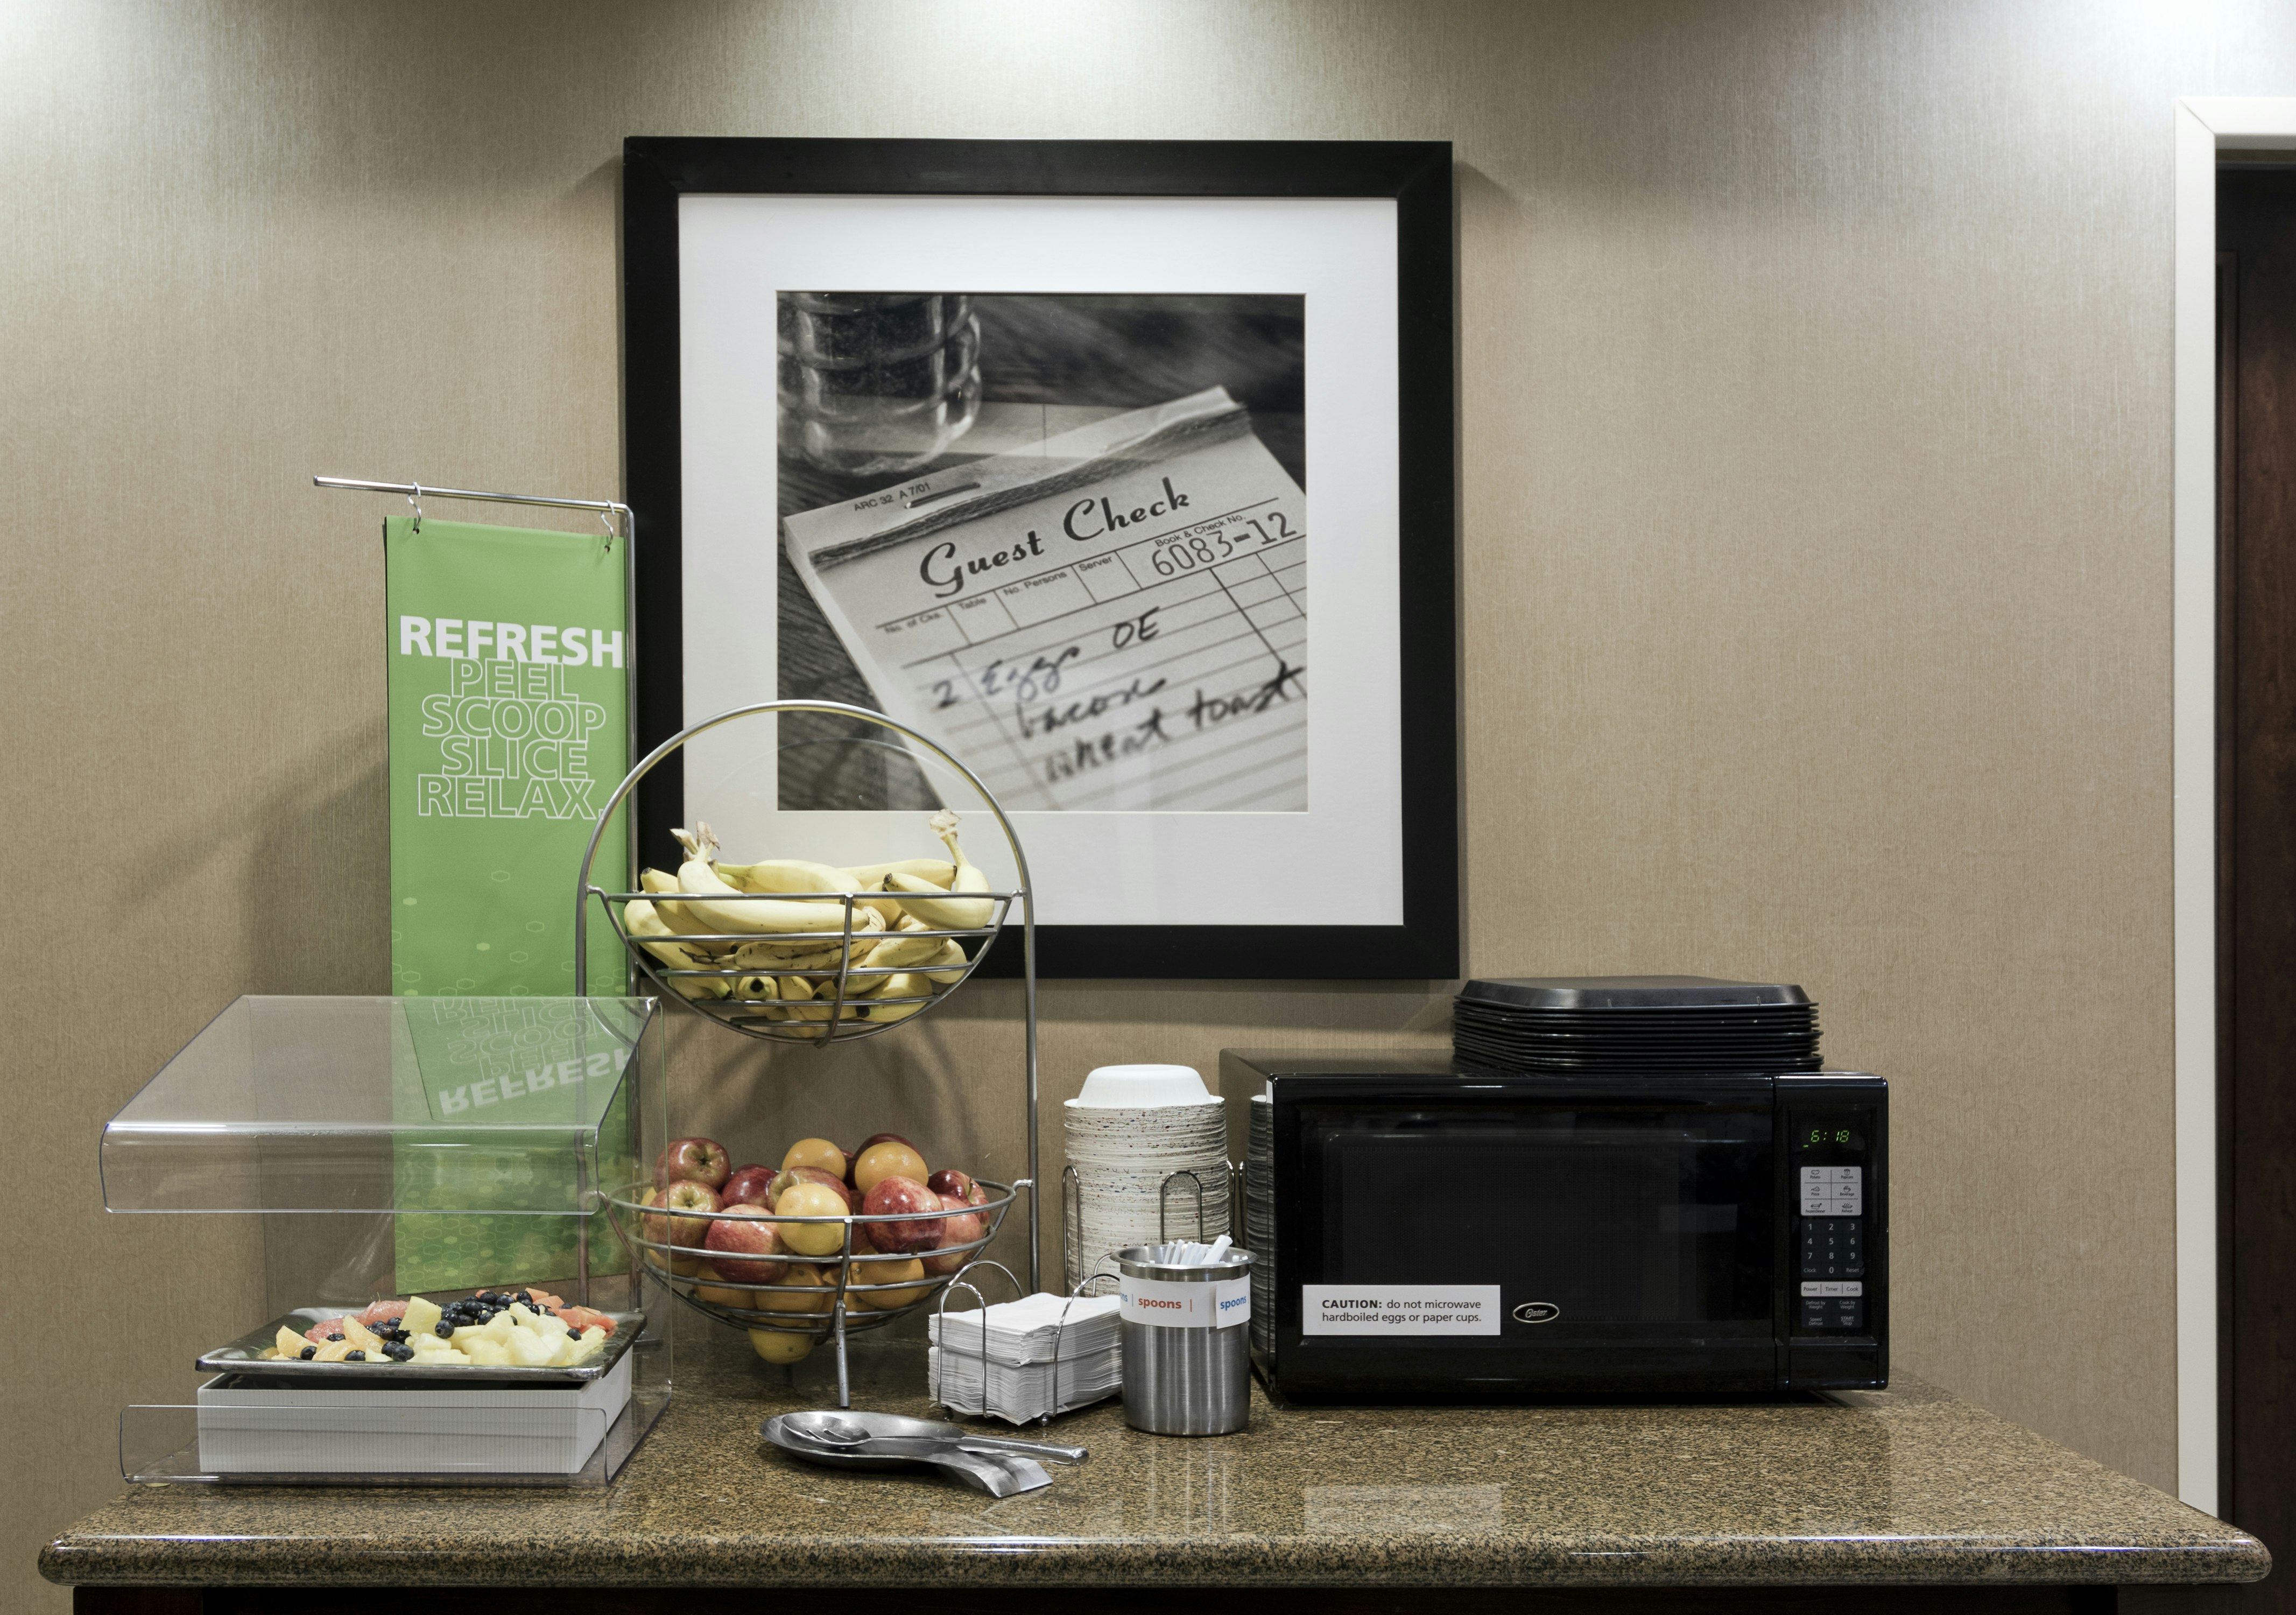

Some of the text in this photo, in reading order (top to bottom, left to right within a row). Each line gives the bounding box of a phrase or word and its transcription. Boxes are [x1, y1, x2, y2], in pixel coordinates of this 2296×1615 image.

[854, 499, 878, 511] ARC
[879, 494, 895, 505] 32
[920, 476, 1189, 599] Guest Check
[1154, 533, 1183, 547] Book
[1194, 519, 1226, 535] Check
[1227, 514, 1246, 524] No.
[1152, 512, 1298, 576] 6083-12
[1079, 555, 1113, 572] Server
[1003, 571, 1067, 595] No. Persons
[958, 596, 987, 611] Table
[400, 615, 623, 669] REFRESH
[933, 680, 962, 710] 2
[1112, 606, 1161, 649] OE
[451, 657, 579, 702] PEEL
[421, 694, 607, 742] SCOOP
[441, 735, 588, 781] SLICE
[1811, 1130, 1849, 1142] 6:18
[1138, 1297, 1182, 1310] spoons
[1220, 1295, 1247, 1311] spoons
[1322, 1299, 1482, 1310] CAUTION: do not microwave
[1525, 1308, 1548, 1318] Oster
[1322, 1312, 1482, 1325] hardboiled eggs or paper cups.
